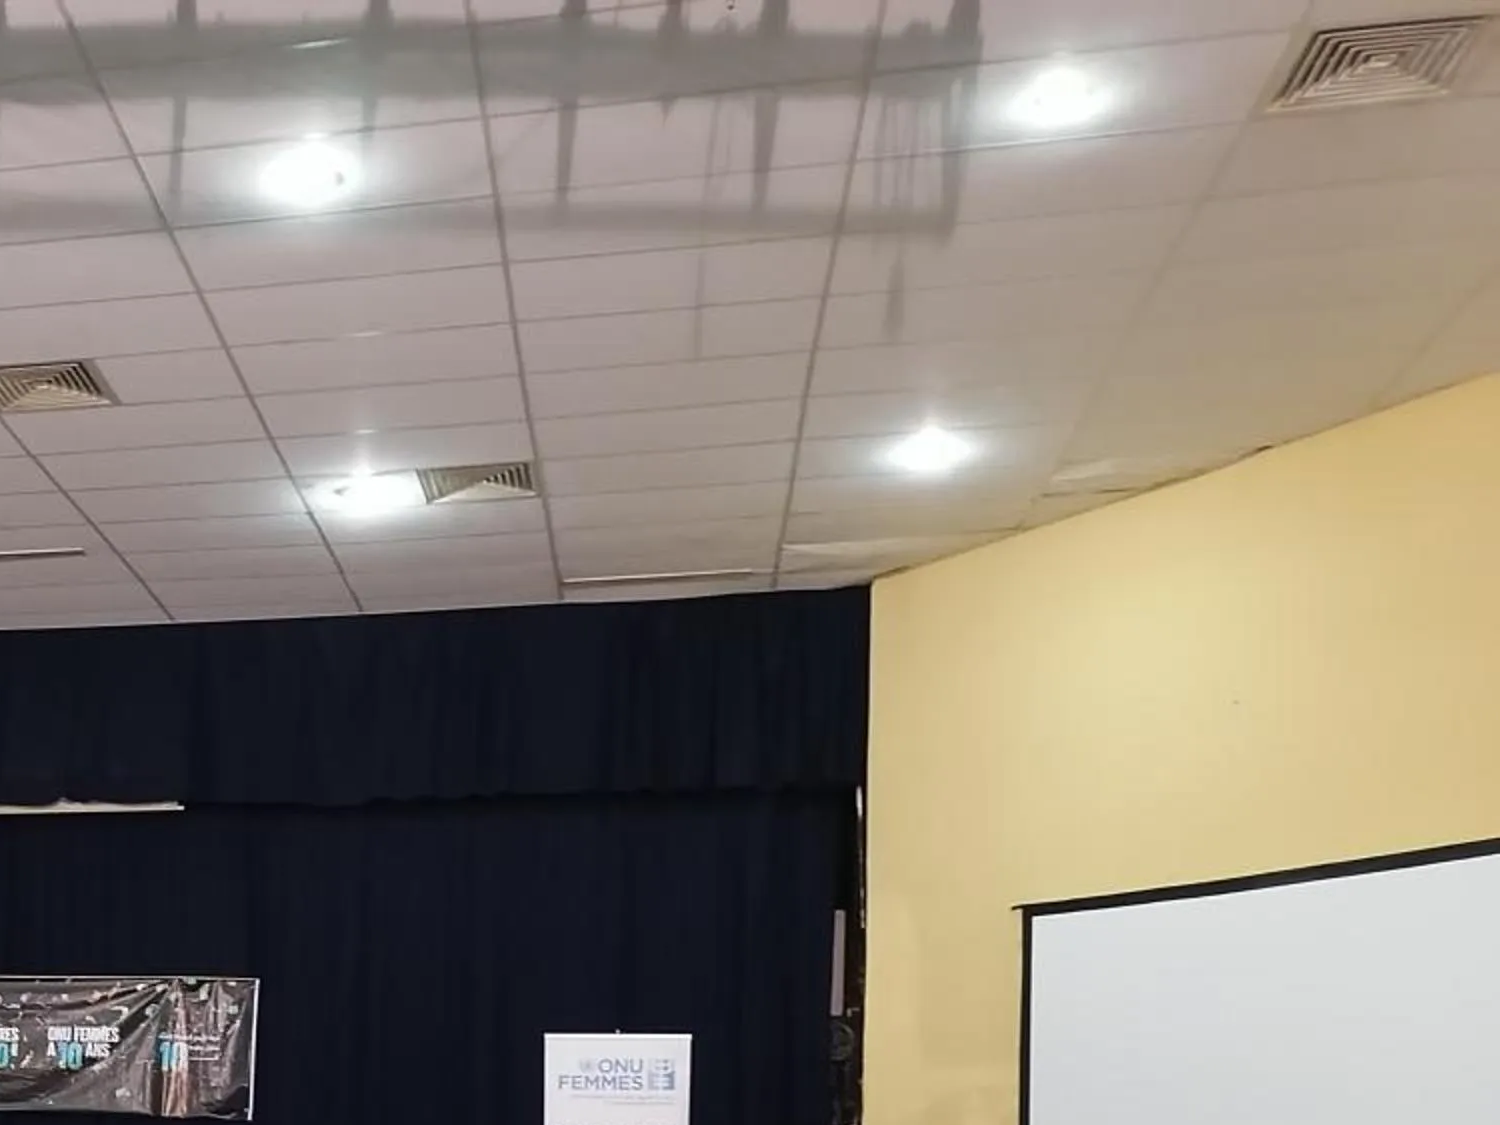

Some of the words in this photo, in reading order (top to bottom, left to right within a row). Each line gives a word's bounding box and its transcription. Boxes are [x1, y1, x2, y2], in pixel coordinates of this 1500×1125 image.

[57, 1041, 82, 1070] 10
[598, 1058, 643, 1074] ONU
[558, 1075, 643, 1091] FEMMES
